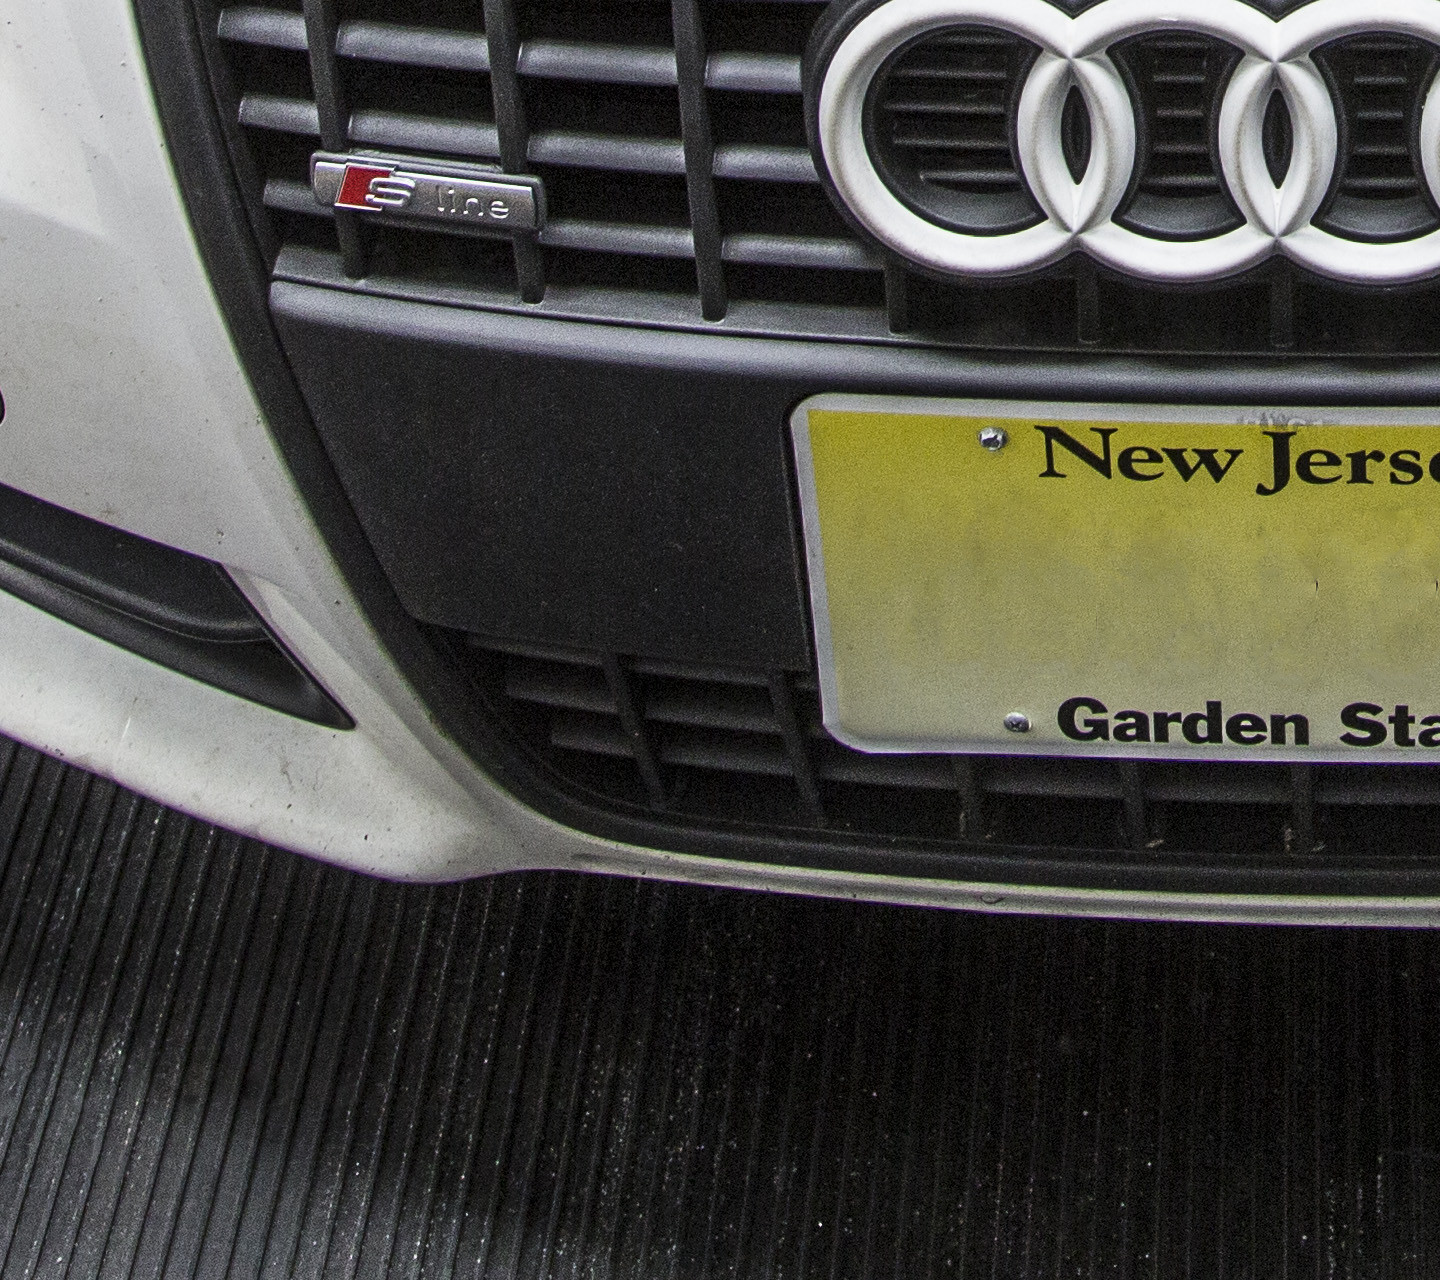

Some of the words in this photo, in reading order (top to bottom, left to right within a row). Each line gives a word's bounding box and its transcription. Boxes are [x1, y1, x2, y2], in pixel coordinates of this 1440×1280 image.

[365, 176, 416, 207] S
[434, 184, 510, 219] line
[1035, 424, 1244, 485] New
[1057, 696, 1310, 747] Garden
